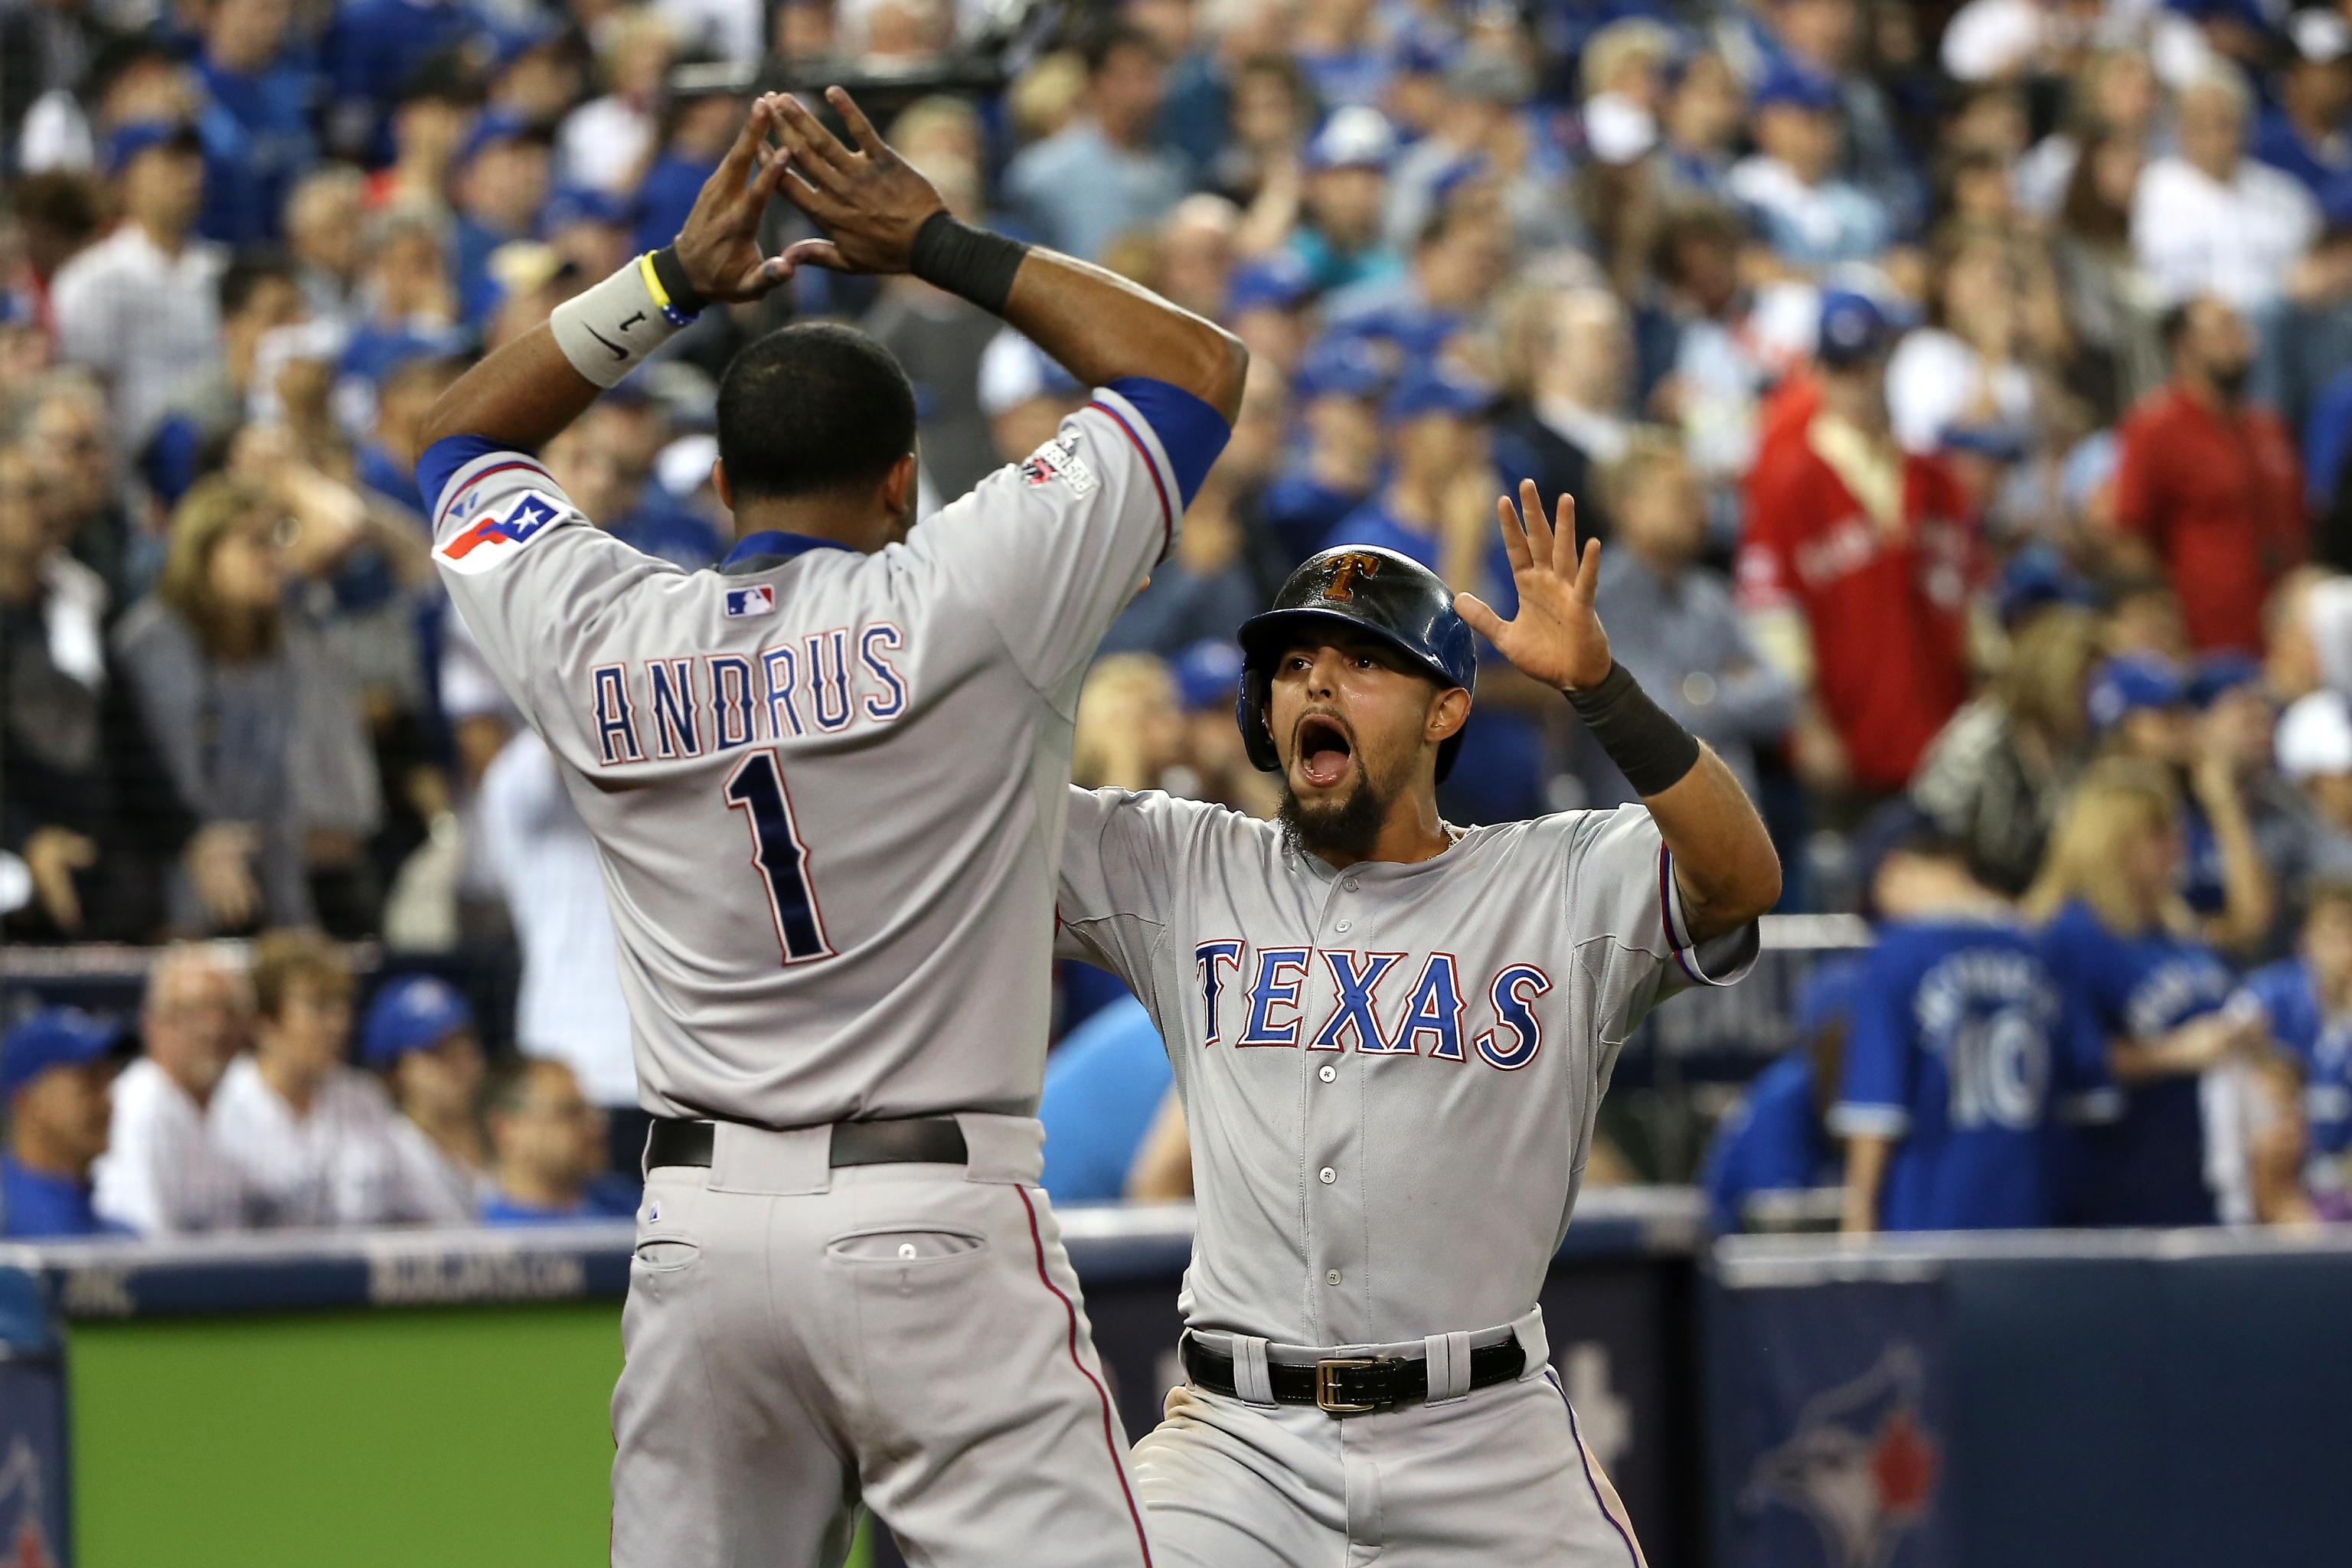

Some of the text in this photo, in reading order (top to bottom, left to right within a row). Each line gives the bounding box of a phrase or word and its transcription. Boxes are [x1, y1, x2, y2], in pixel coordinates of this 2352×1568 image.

[619, 311, 646, 332] 1
[1323, 553, 1380, 603] T
[591, 622, 909, 766] ANDRUS
[722, 746, 840, 966] 1
[1195, 939, 1553, 1072] TEXAS
